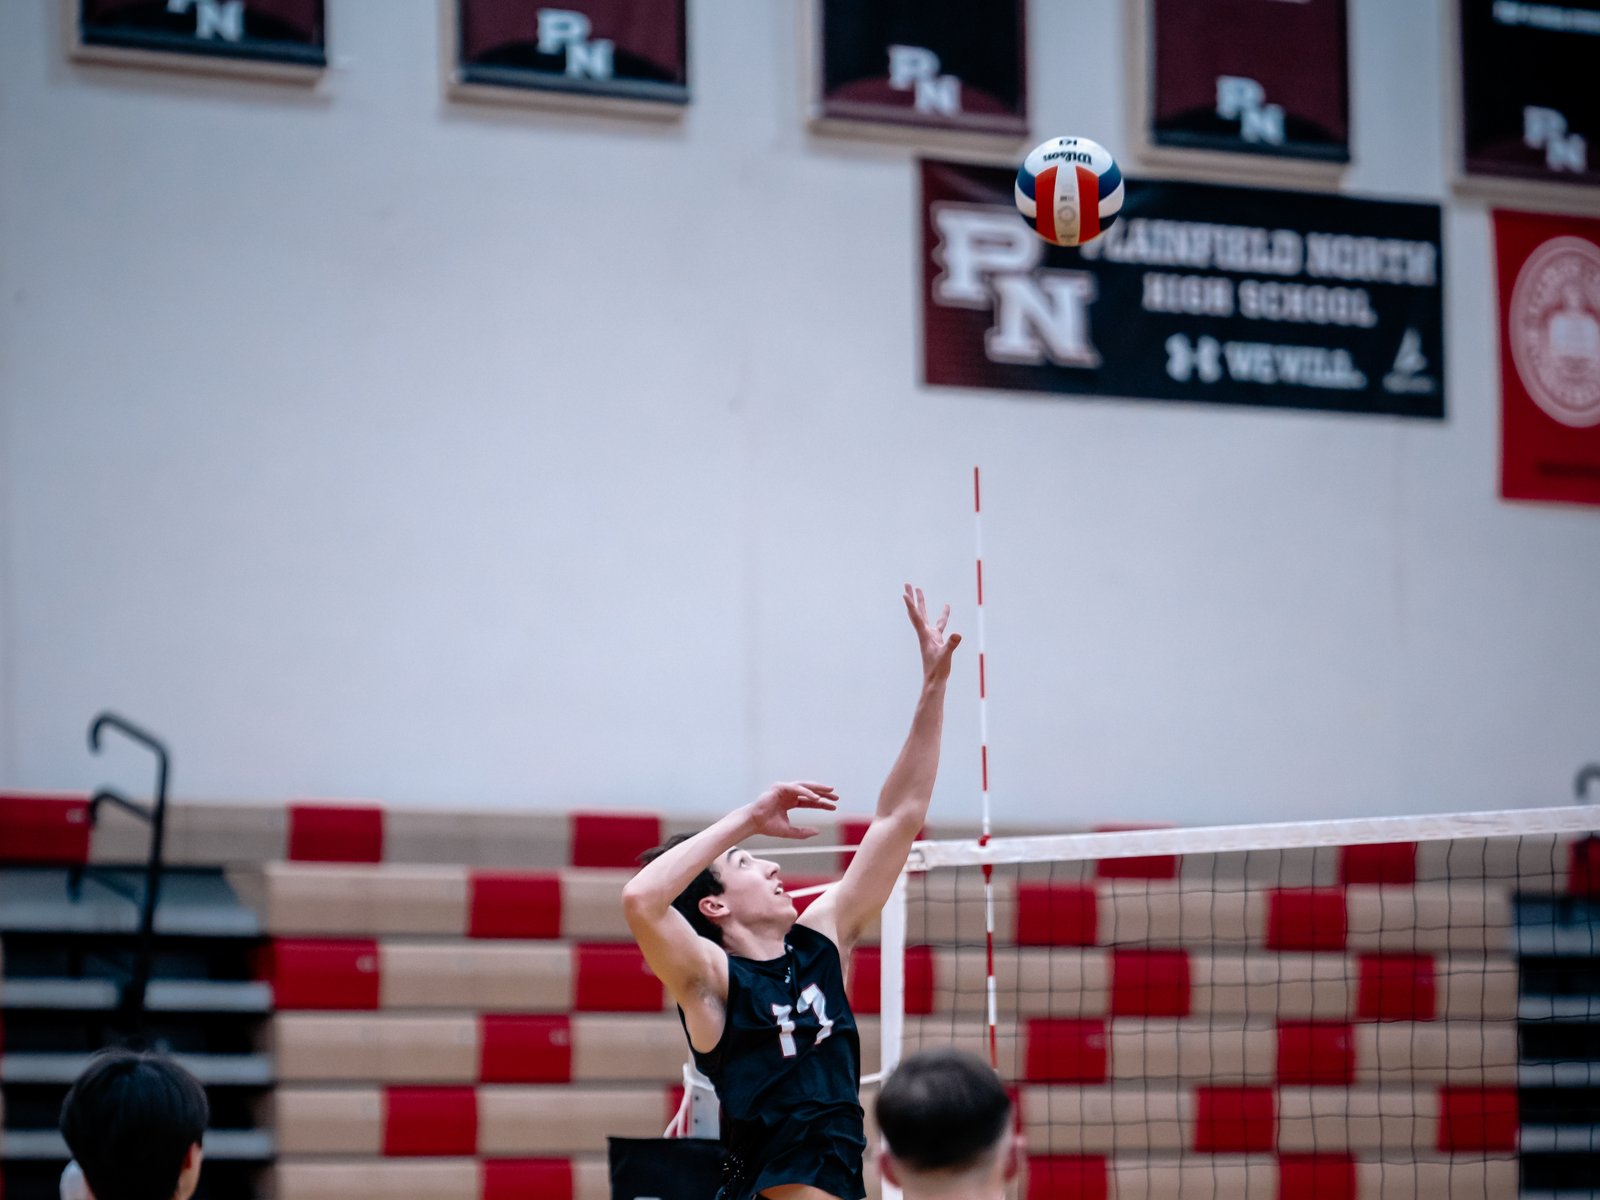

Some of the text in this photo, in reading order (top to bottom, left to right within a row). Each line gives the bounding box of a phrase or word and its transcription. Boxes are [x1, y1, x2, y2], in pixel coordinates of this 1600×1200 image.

[1043, 151, 1092, 165] Wilson
[1306, 232, 1437, 286] NORTH
[931, 207, 1101, 369] PN
[1142, 271, 1380, 328] HIGH SCHOOL
[771, 983, 834, 1058] 17
